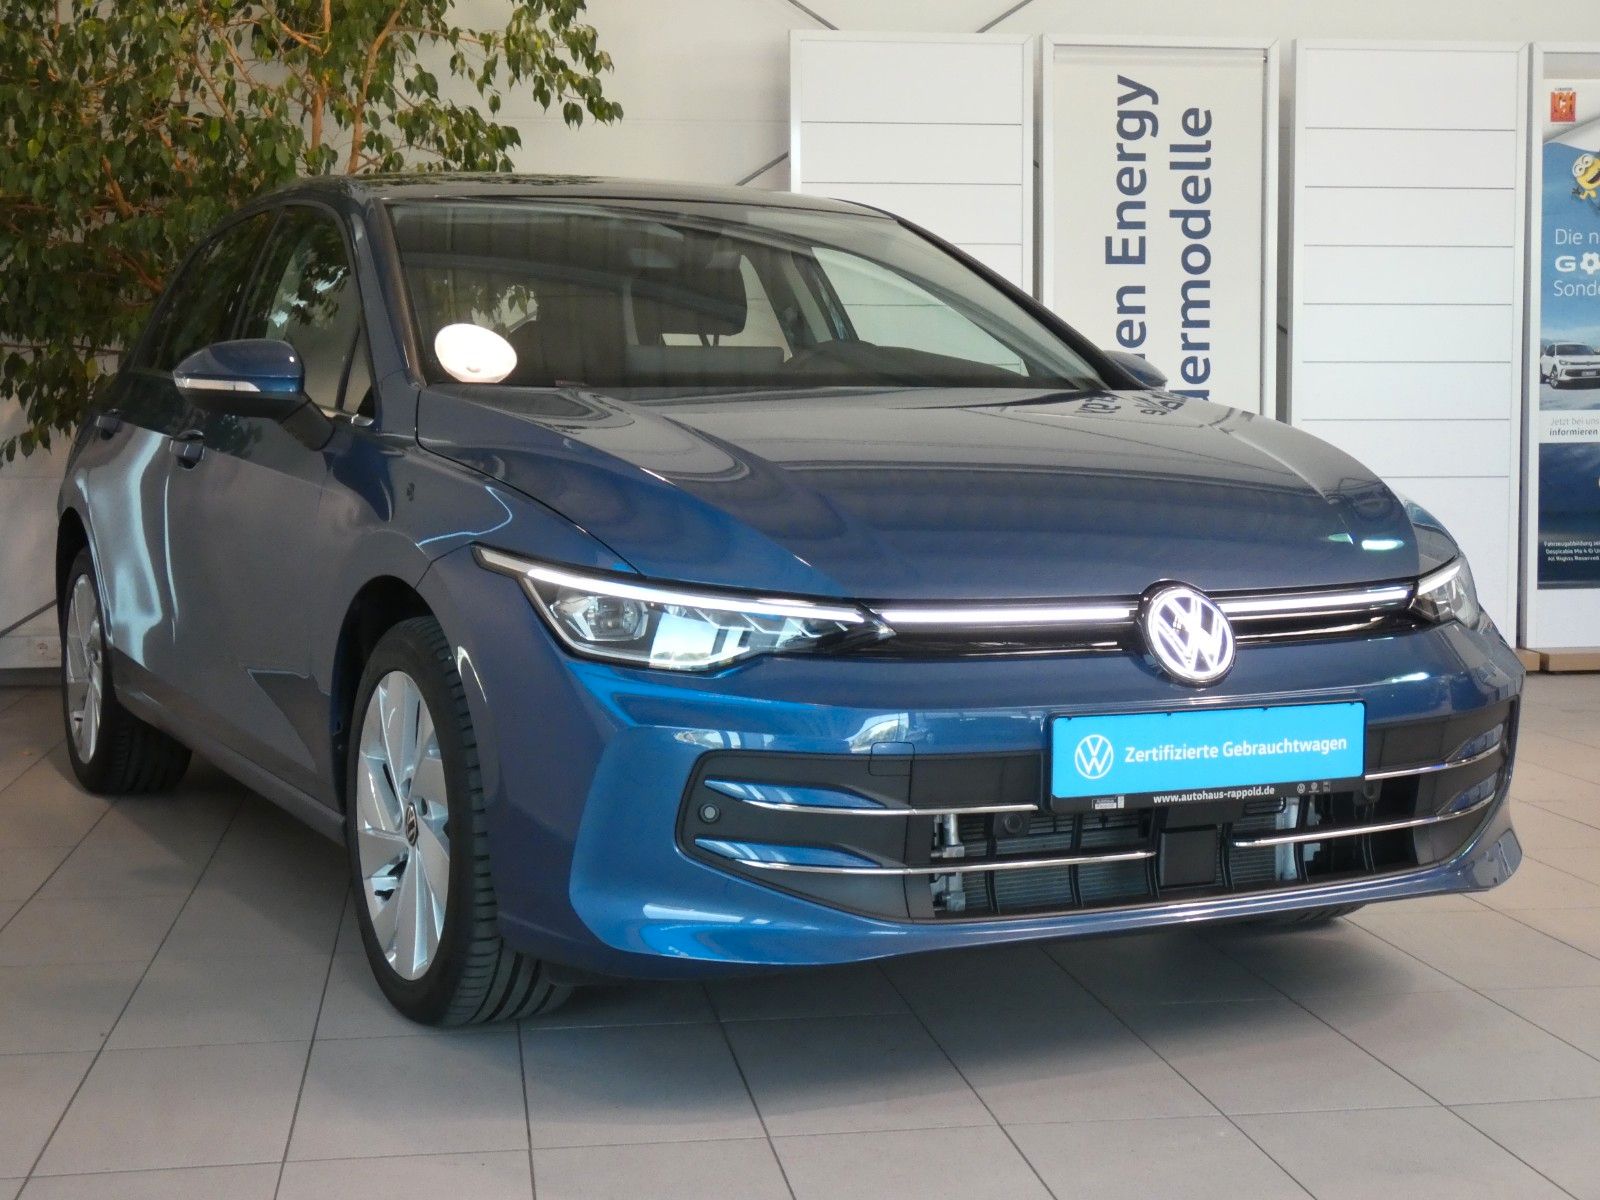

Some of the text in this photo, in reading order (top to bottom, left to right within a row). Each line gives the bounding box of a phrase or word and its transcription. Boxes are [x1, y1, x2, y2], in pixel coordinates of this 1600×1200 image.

[1105, 74, 1159, 359] en Energy
[1555, 228, 1583, 245] Die
[1553, 280, 1600, 297] Sond
[1551, 417, 1600, 426] Jetzt bei uns
[1549, 427, 1598, 436] informieren
[1074, 734, 1114, 779] VW
[1125, 737, 1348, 763] Zertifizierte Gebrauchtwagen
[1153, 785, 1275, 804] www.autohaus-rappold.de
